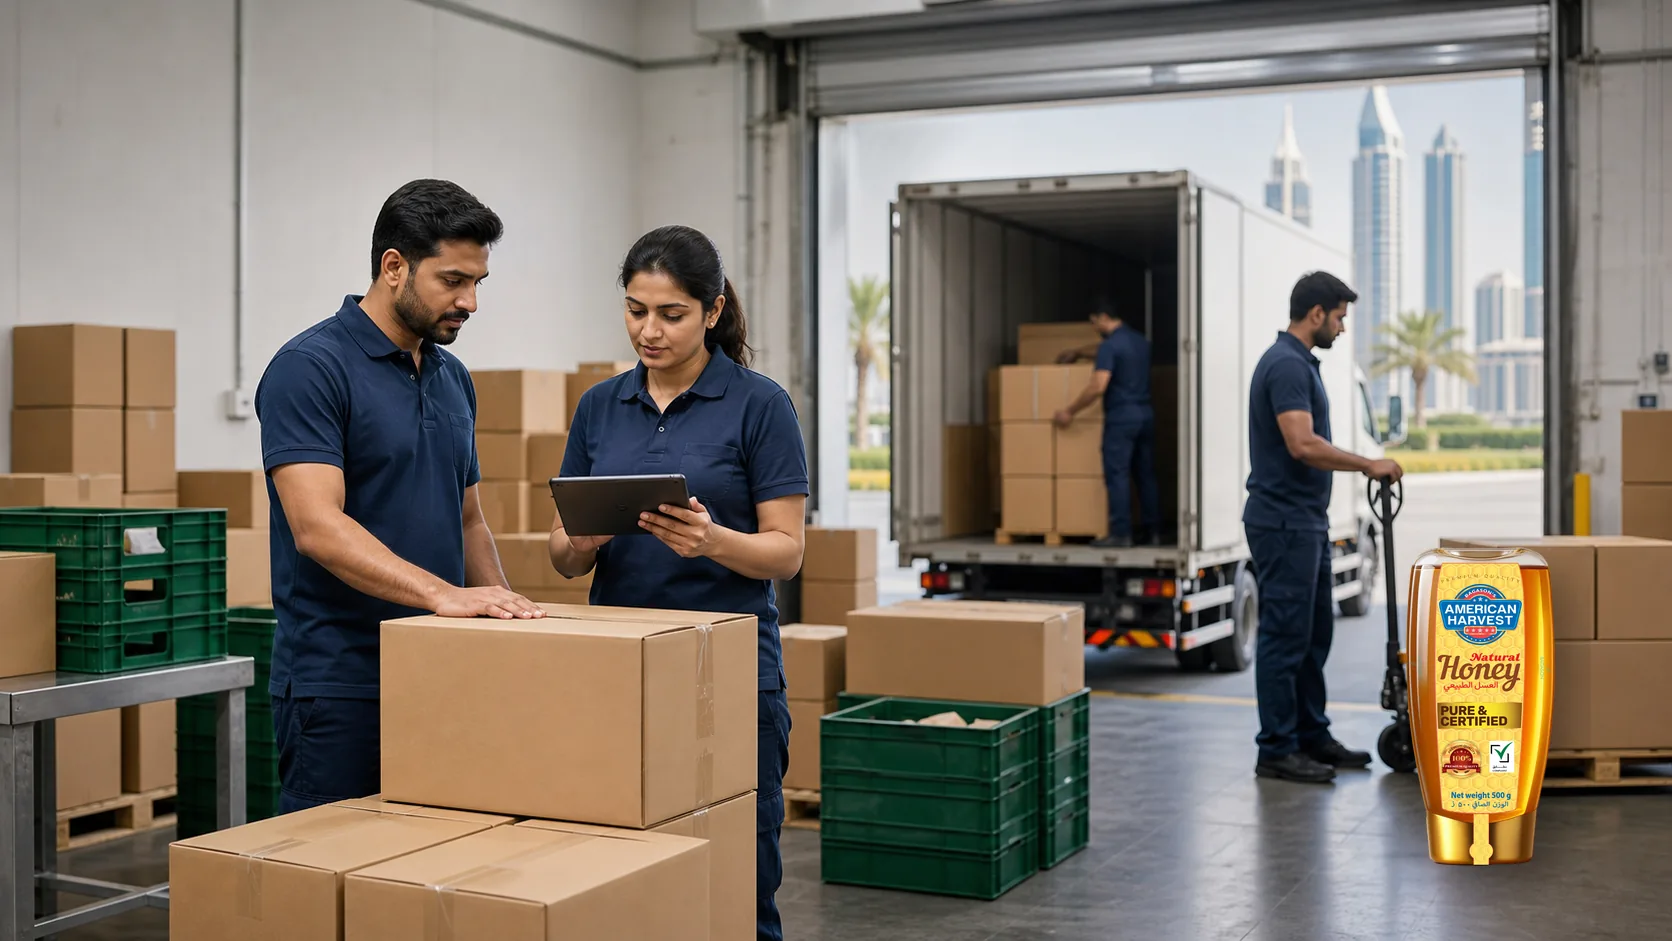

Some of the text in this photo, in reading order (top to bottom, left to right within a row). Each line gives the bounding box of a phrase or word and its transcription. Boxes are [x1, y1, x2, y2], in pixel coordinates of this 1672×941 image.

[1445, 604, 1516, 614] AMERICAN
[1448, 615, 1513, 625] HARVEST
[1470, 653, 1521, 662] Natural
[1437, 655, 1520, 691] Honey
[1443, 681, 1498, 692] العسل الطبيعي
[1440, 706, 1487, 715] PURE &
[1440, 716, 1507, 726] CERTIFIED
[1465, 792, 1490, 800] weight
[1492, 801, 1509, 809] الوزن
